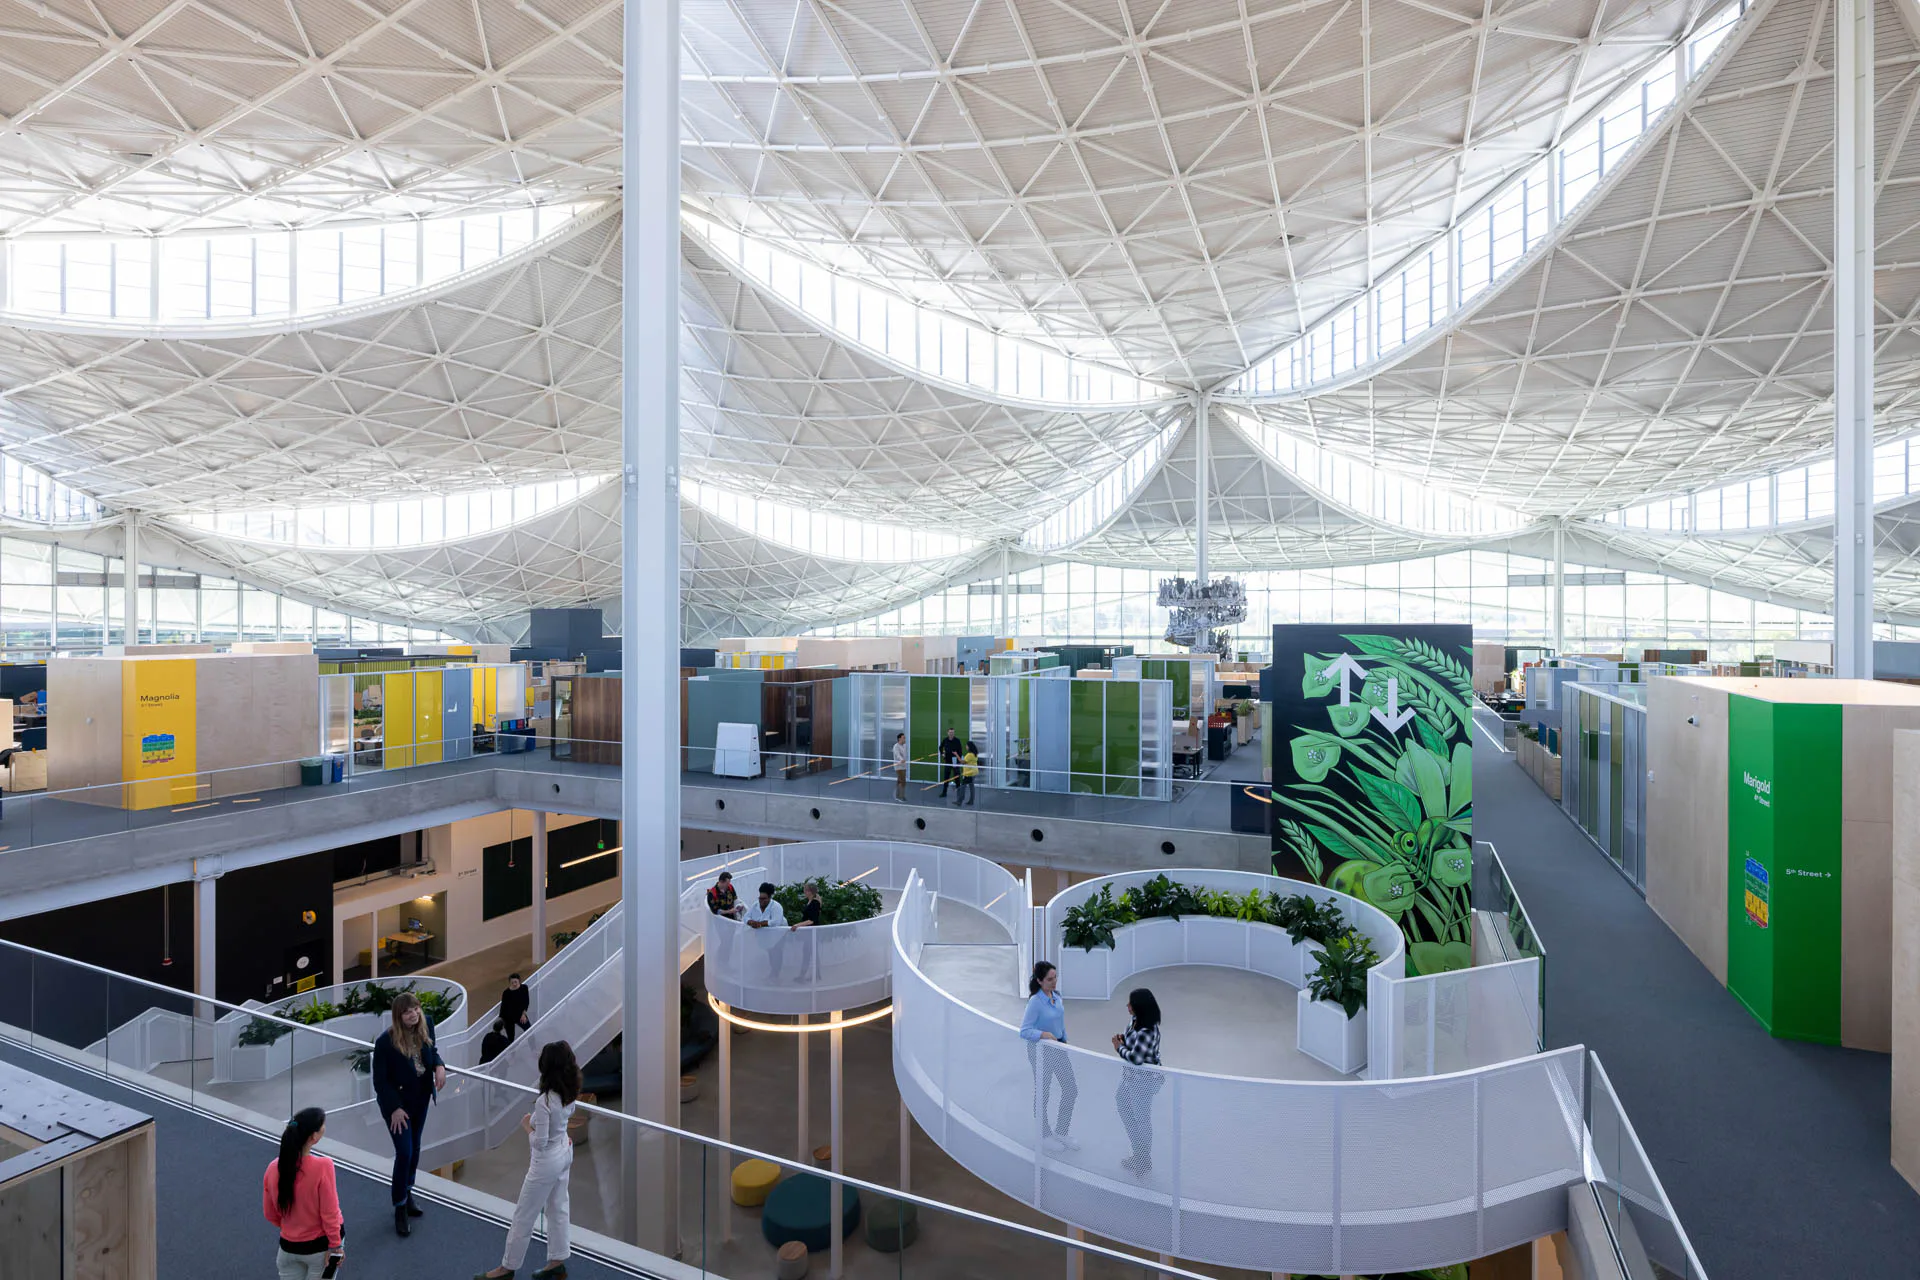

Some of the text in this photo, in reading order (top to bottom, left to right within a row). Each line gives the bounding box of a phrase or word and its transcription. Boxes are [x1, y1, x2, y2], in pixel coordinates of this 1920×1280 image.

[140, 693, 180, 702] Magnolia
[1743, 770, 1770, 794] Marigold
[1797, 869, 1823, 878] Street
